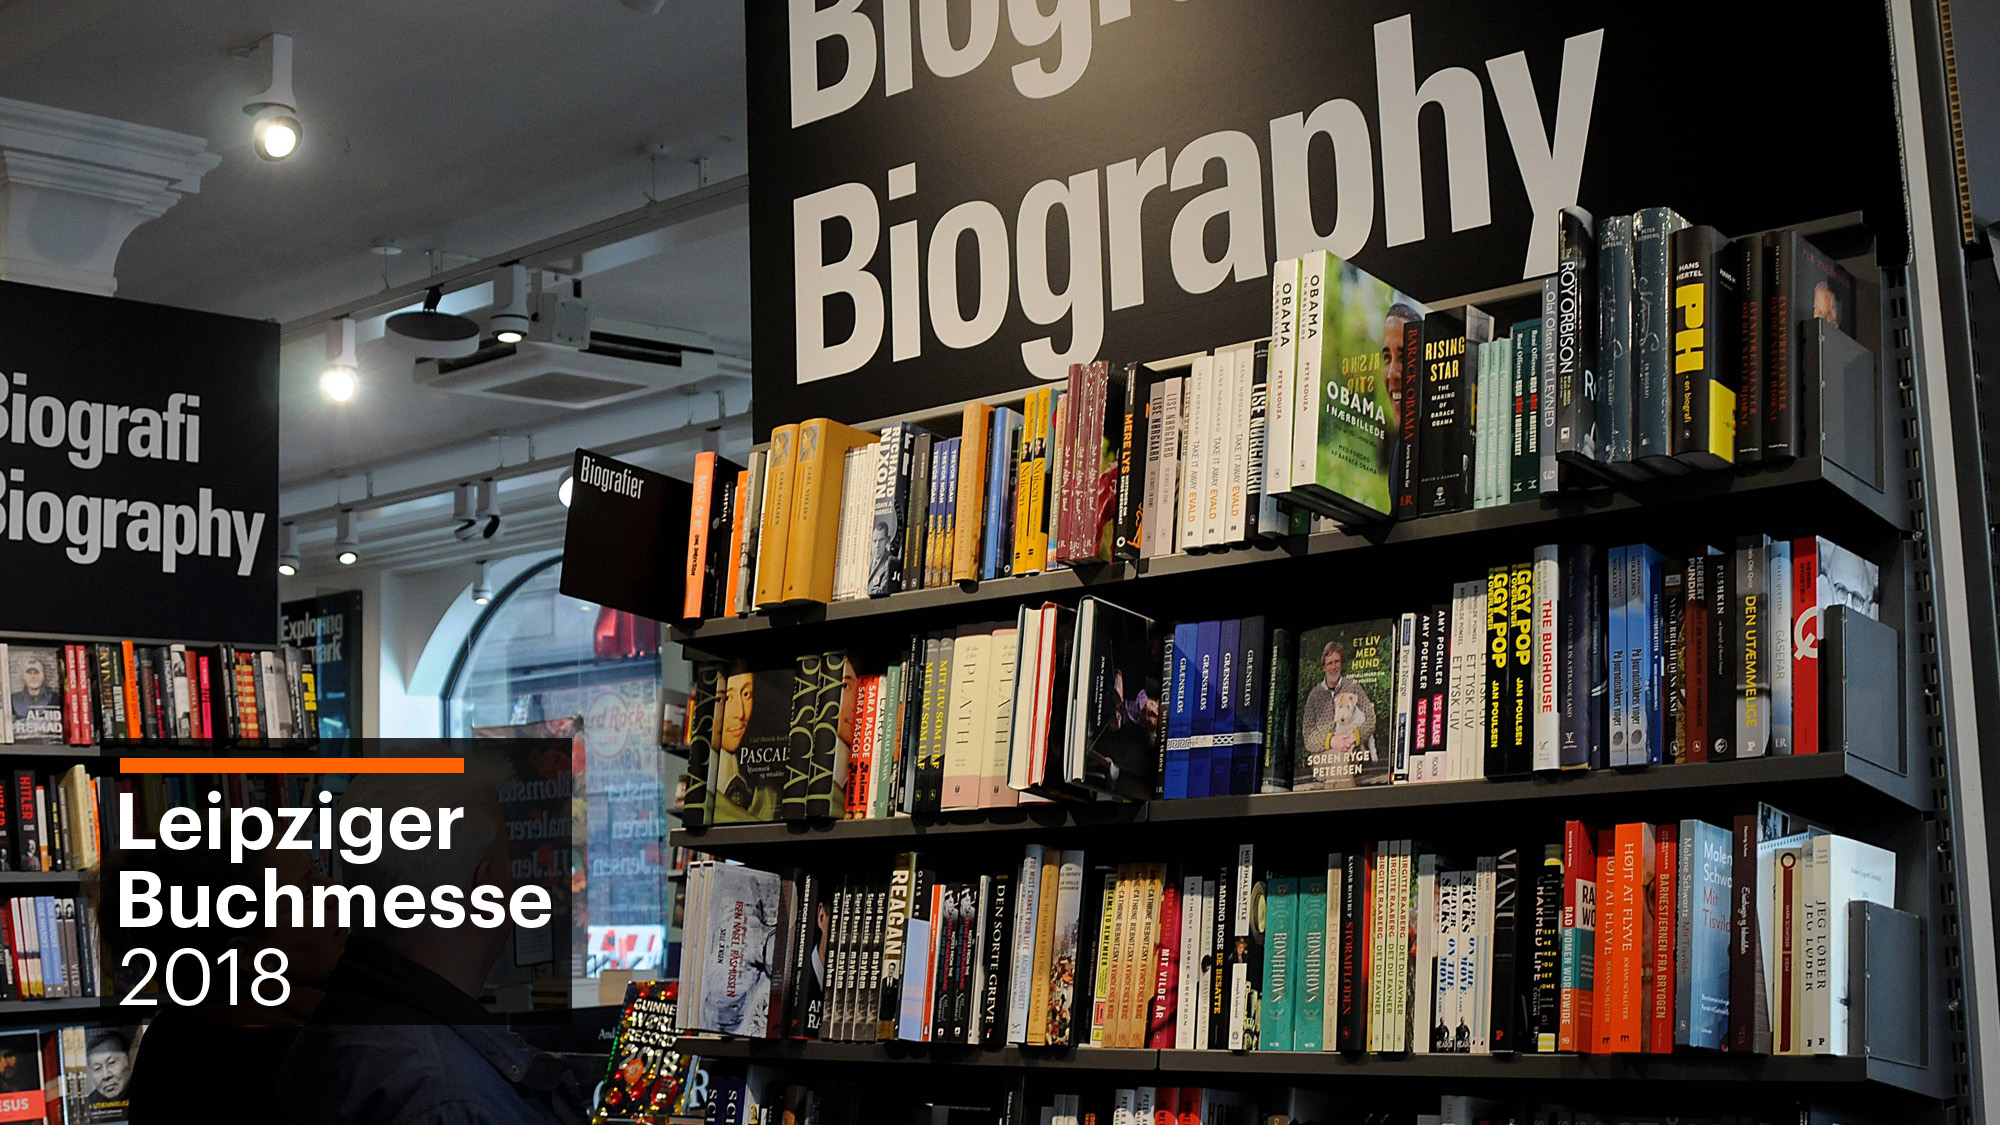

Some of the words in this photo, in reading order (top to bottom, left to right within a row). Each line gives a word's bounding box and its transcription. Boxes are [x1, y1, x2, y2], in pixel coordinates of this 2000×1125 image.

[794, 14, 1604, 385] Biography
[1561, 261, 1575, 296] ROY
[1676, 268, 1703, 281] HERTEL
[1679, 261, 1699, 272] HANS
[1281, 282, 1292, 348] OBAMA
[1308, 274, 1319, 340] OBAMA
[1546, 291, 1556, 318] Olaf
[1546, 319, 1555, 351] Olsen
[1559, 299, 1574, 374] ORBISON
[1676, 282, 1704, 375] PH
[1406, 328, 1418, 384] BARACK
[1425, 335, 1465, 361] RISING
[1546, 354, 1554, 374] MIT
[1430, 360, 1459, 382] STAR
[1152, 396, 1163, 415] LISE
[1166, 392, 1177, 412] LISE
[1327, 380, 1386, 425] OBAMA
[1431, 392, 1455, 401] MAKING
[1545, 377, 1554, 428] LEVNED
[1682, 392, 1692, 423] biografi
[0, 371, 200, 469] iografi
[1331, 406, 1385, 440] NÆRBILLEDE
[1404, 388, 1416, 441] OBAMA
[1430, 409, 1455, 419] BARACK
[1431, 418, 1453, 427] OBAMA
[1123, 413, 1133, 449] MERE
[1234, 433, 1243, 452] TAKE
[581, 455, 644, 499] Biografier
[875, 427, 892, 499] NIXON
[886, 426, 900, 499] RICHARD
[940, 450, 948, 480] TREVOR
[949, 448, 957, 480] TREVOR
[1121, 449, 1131, 473] LYS
[1232, 462, 1241, 484] AWAY
[938, 482, 946, 504] NOAH
[1187, 491, 1197, 522] EVALD
[1209, 488, 1219, 520] EVALD
[1230, 485, 1241, 517] EVALD
[0, 467, 266, 576] iography
[1688, 557, 1696, 602] PUNDIK
[1716, 564, 1724, 615] PUSHKIN
[1422, 615, 1430, 638] AMY
[1437, 610, 1445, 633] AMY
[1542, 600, 1552, 627] THE
[1745, 595, 1756, 626] DEN
[1352, 637, 1363, 647] ET
[1365, 635, 1381, 646] LIV
[1355, 647, 1376, 658] MED
[1515, 618, 1531, 666] POP
[938, 660, 948, 686] MIT
[1351, 658, 1380, 670] HUND
[1419, 641, 1429, 690] POEHLER
[1435, 636, 1445, 685] POEHLER
[1452, 655, 1462, 670] ET
[1541, 633, 1552, 713] BUGHOUSE
[1451, 674, 1461, 707] TYSK
[1745, 629, 1757, 727] UTÆMMELIGE
[866, 685, 876, 714] SARA
[936, 688, 946, 709] LIV
[1418, 699, 1427, 715] YES
[1433, 694, 1442, 710] YES
[781, 654, 822, 805] PASCAL
[808, 651, 847, 801] PASCAL
[934, 710, 944, 740] SOM
[1416, 717, 1426, 749] PLEASE
[1432, 713, 1441, 746] PLEASE
[1449, 710, 1459, 730] LIV
[1515, 699, 1523, 746] POULSEN
[862, 717, 874, 759] PASCOE
[740, 746, 790, 765] PASCAL
[1307, 752, 1341, 766] SØREN
[1343, 750, 1370, 763] RYGE
[1312, 764, 1363, 778] PETERSEN
[19, 775, 34, 821] HITLER
[1623, 843, 1634, 882] HØJT
[1683, 837, 1693, 873] Malene
[1400, 855, 1408, 894] BIRGITTE
[994, 884, 1006, 917] DEN
[1441, 877, 1450, 934] SACKS
[1623, 884, 1633, 905] AT
[1682, 874, 1692, 918] Schwartz
[1703, 886, 1719, 903] Mit
[883, 869, 909, 955] REAGAN
[1399, 896, 1407, 939] RAABERG
[1564, 906, 1573, 926] RAD
[1657, 873, 1669, 951] BARNESTJERNEN
[1816, 901, 1827, 929] JEG
[990, 921, 1002, 971] SORTE
[1101, 925, 1109, 967] REMEMBER
[1216, 923, 1225, 953] ROSE
[1563, 928, 1573, 964] WOMEN
[1621, 908, 1633, 952] FLYVE
[826, 950, 835, 988] mayhem
[870, 950, 880, 990] mayhem
[1161, 948, 1170, 966] MIT
[1216, 953, 1223, 966] DE
[1398, 964, 1405, 977] DU
[1657, 954, 1667, 972] FRA
[1816, 934, 1827, 990] LØBER
[985, 974, 998, 1024] GREVE
[1158, 968, 1168, 1001] VILDE
[1213, 968, 1223, 1015] BESATTE
[1396, 980, 1405, 1015] FAVNER
[1561, 967, 1572, 1025] WORLDWIDE
[1656, 974, 1667, 1019] BRYGGEN
